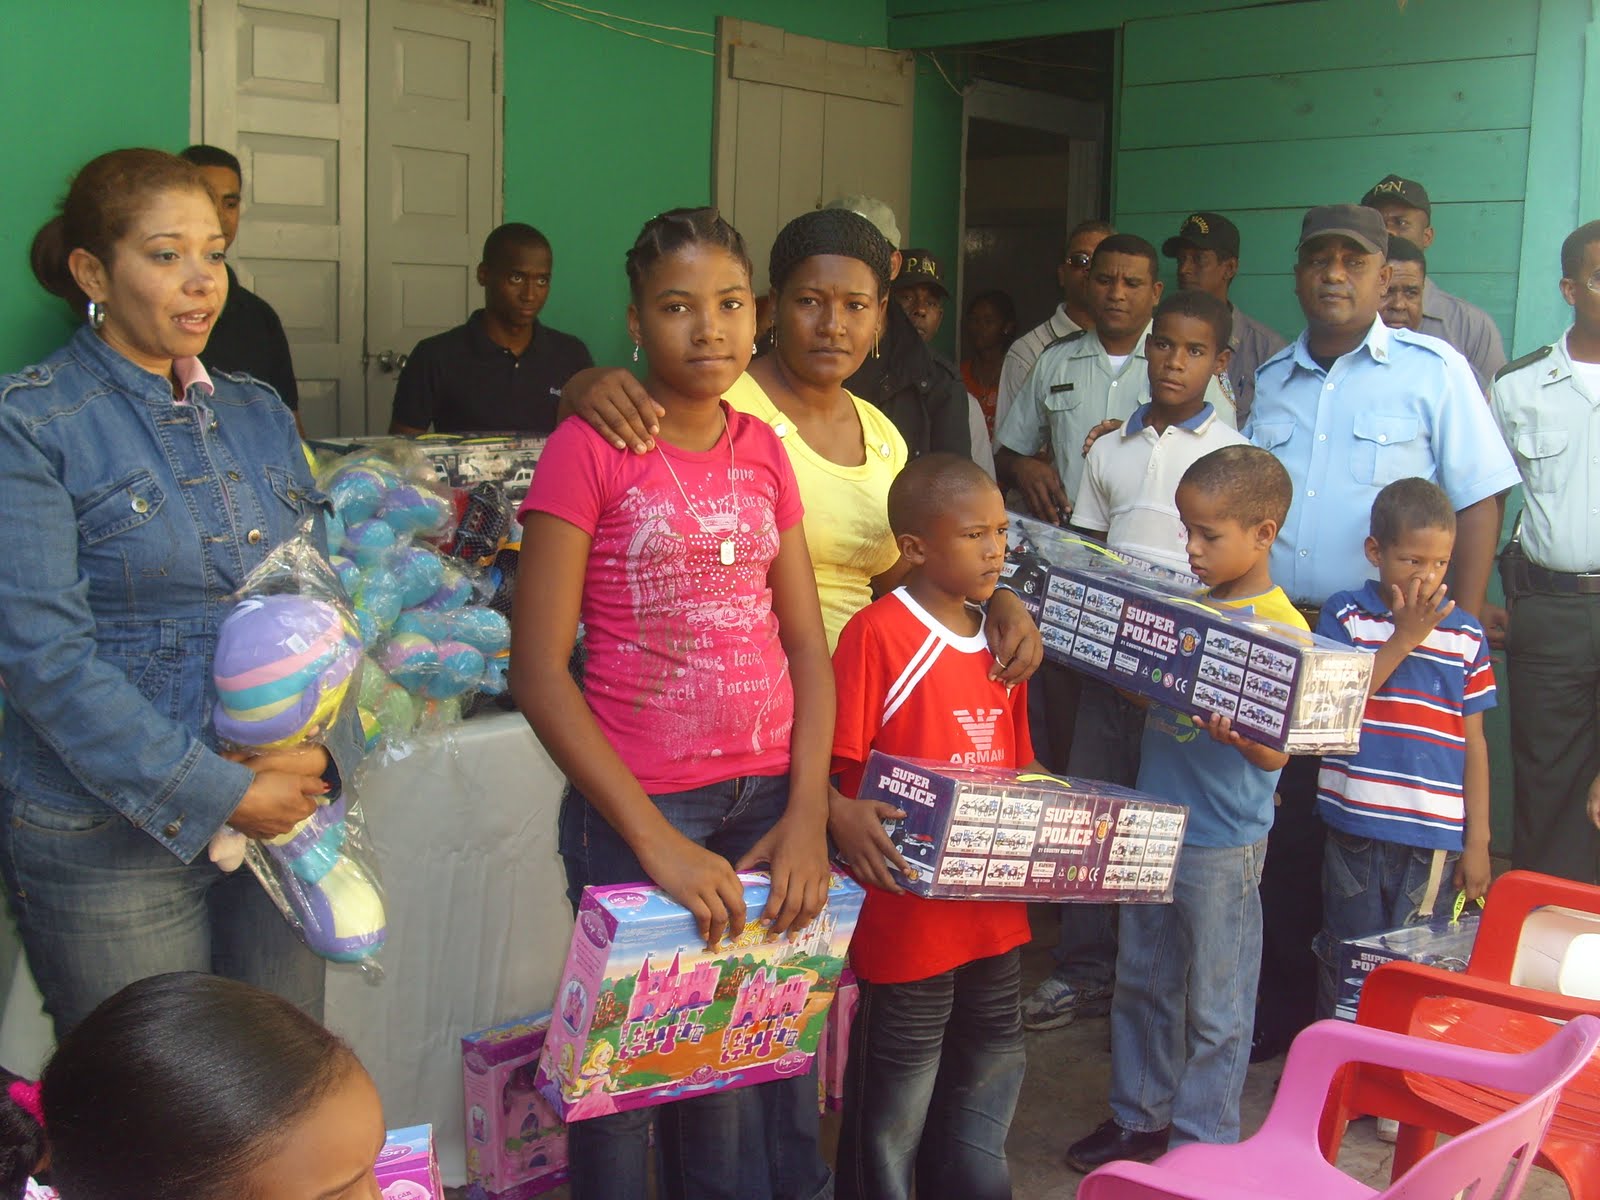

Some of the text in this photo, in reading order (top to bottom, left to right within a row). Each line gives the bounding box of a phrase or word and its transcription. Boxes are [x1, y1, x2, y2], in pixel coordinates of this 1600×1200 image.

[1126, 606, 1175, 634] SUPER
[1121, 622, 1179, 655] POLICE
[891, 767, 930, 789] SUPER
[878, 776, 936, 807] POLICE
[1044, 808, 1091, 825] SUPER
[1039, 827, 1093, 846] POLICE
